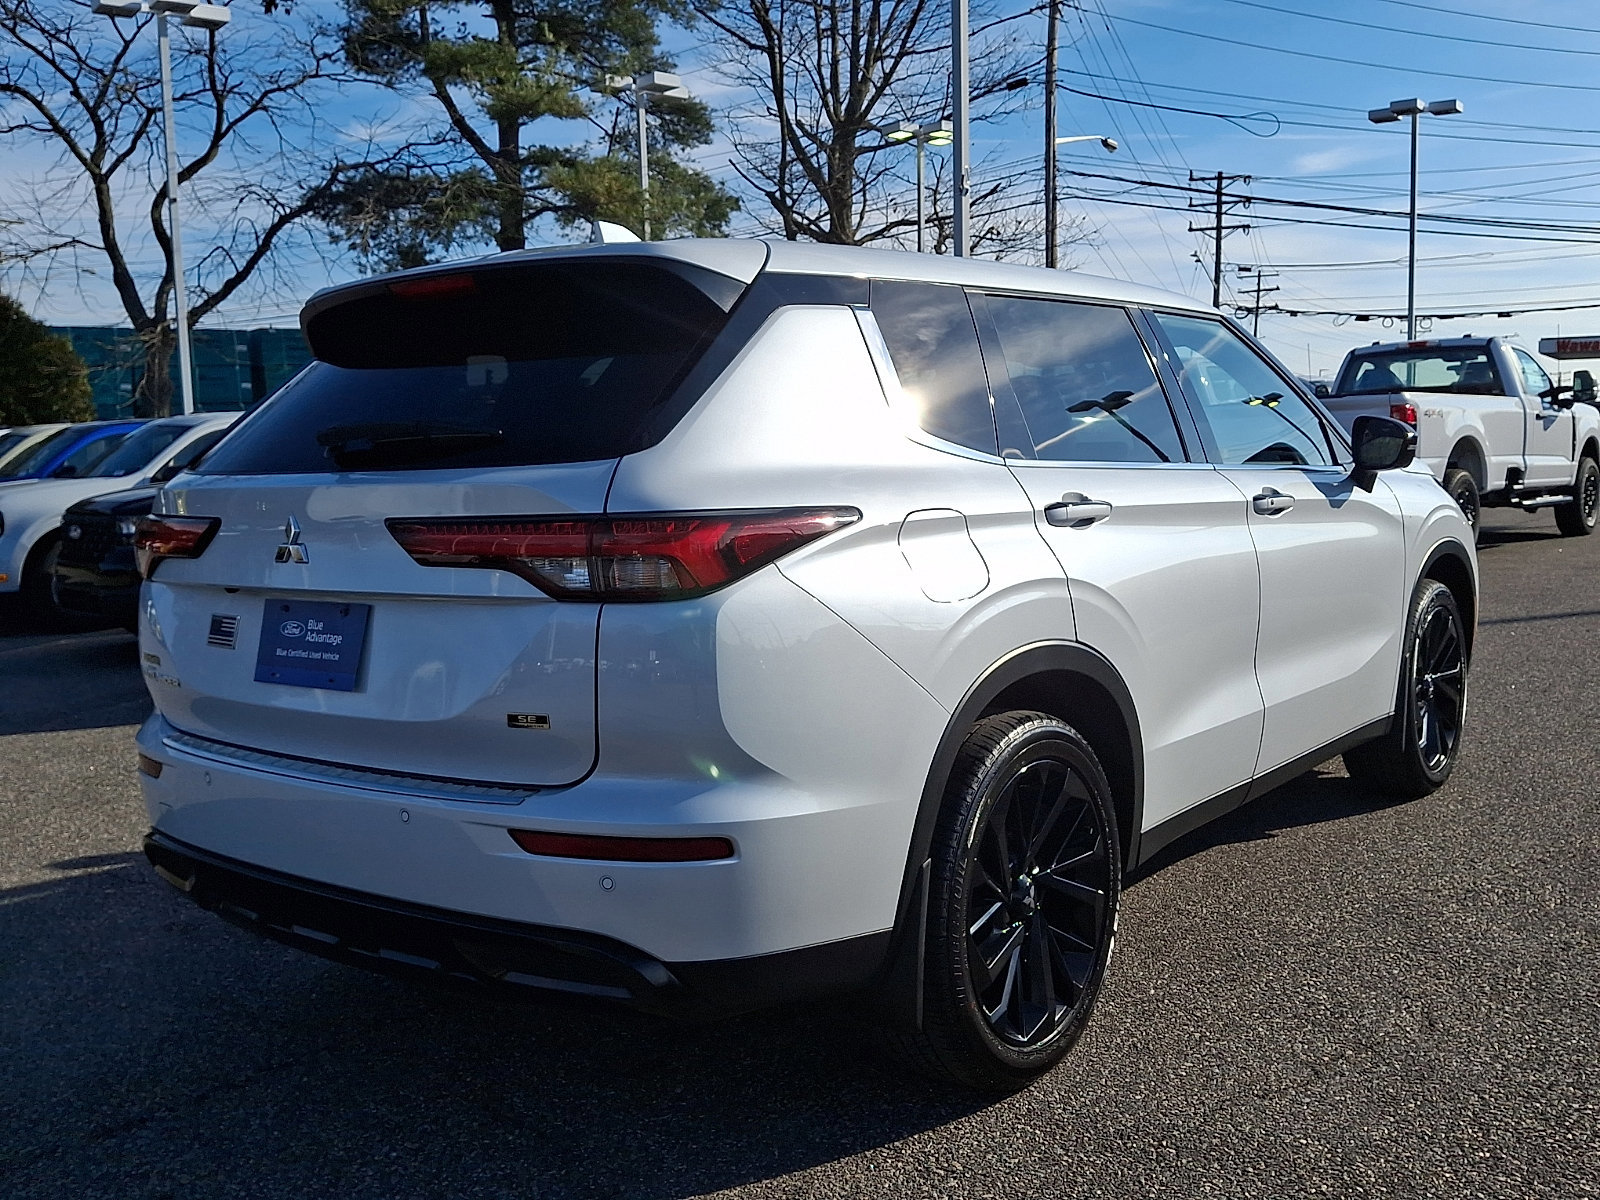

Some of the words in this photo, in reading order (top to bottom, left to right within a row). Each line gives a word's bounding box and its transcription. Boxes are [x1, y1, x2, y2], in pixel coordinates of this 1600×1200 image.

[1557, 338, 1600, 351] Wawa
[283, 622, 302, 635] Ford
[307, 619, 324, 631] Blue
[305, 631, 343, 646] Advantage
[276, 648, 288, 656] Blue
[287, 649, 308, 658] Certified
[308, 651, 322, 659] Used
[322, 652, 340, 661] Vehicle
[517, 715, 537, 723] SE
